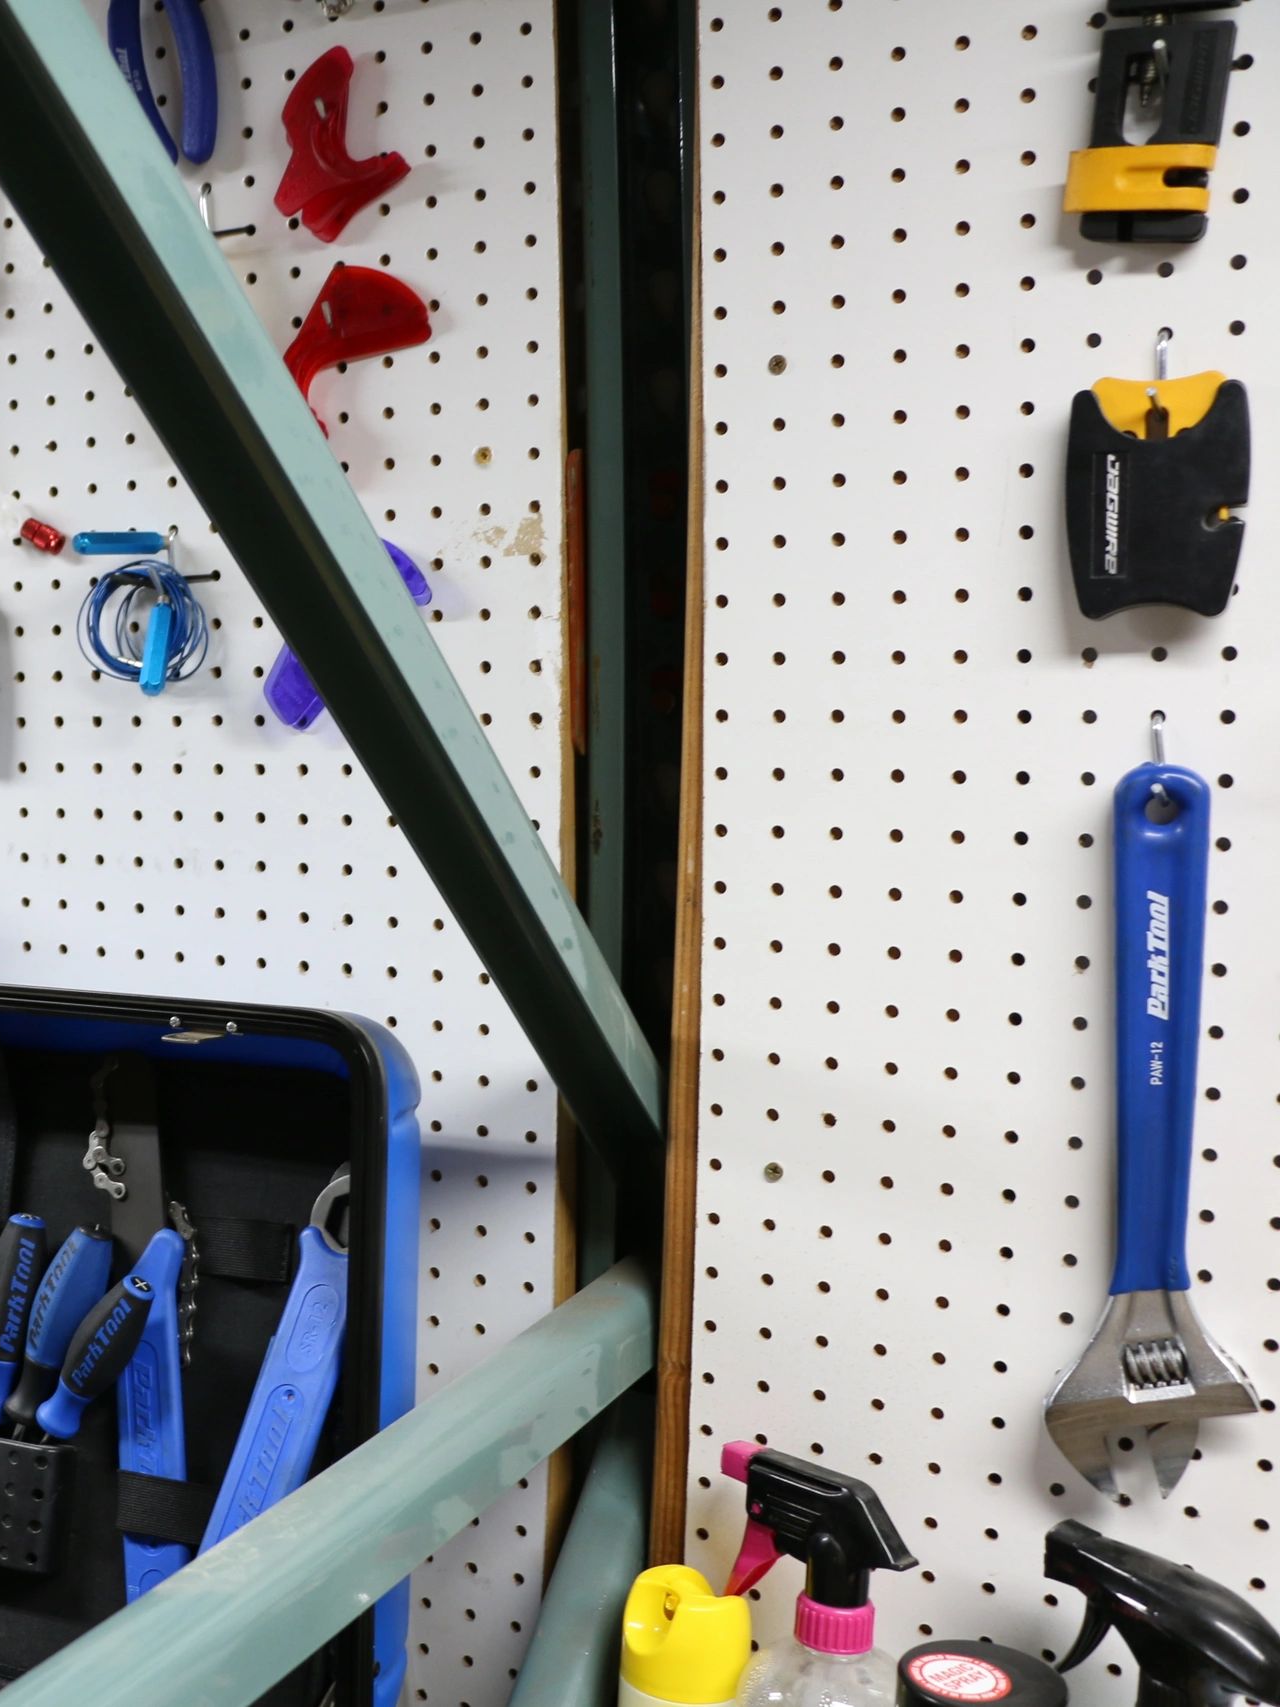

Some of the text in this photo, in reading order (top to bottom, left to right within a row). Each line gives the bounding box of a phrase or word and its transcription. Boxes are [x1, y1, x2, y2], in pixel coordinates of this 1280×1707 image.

[1150, 1041, 1163, 1086] PAW-12
[928, 1663, 974, 1682] MAGIC
[943, 1670, 988, 1690] SPRAY
